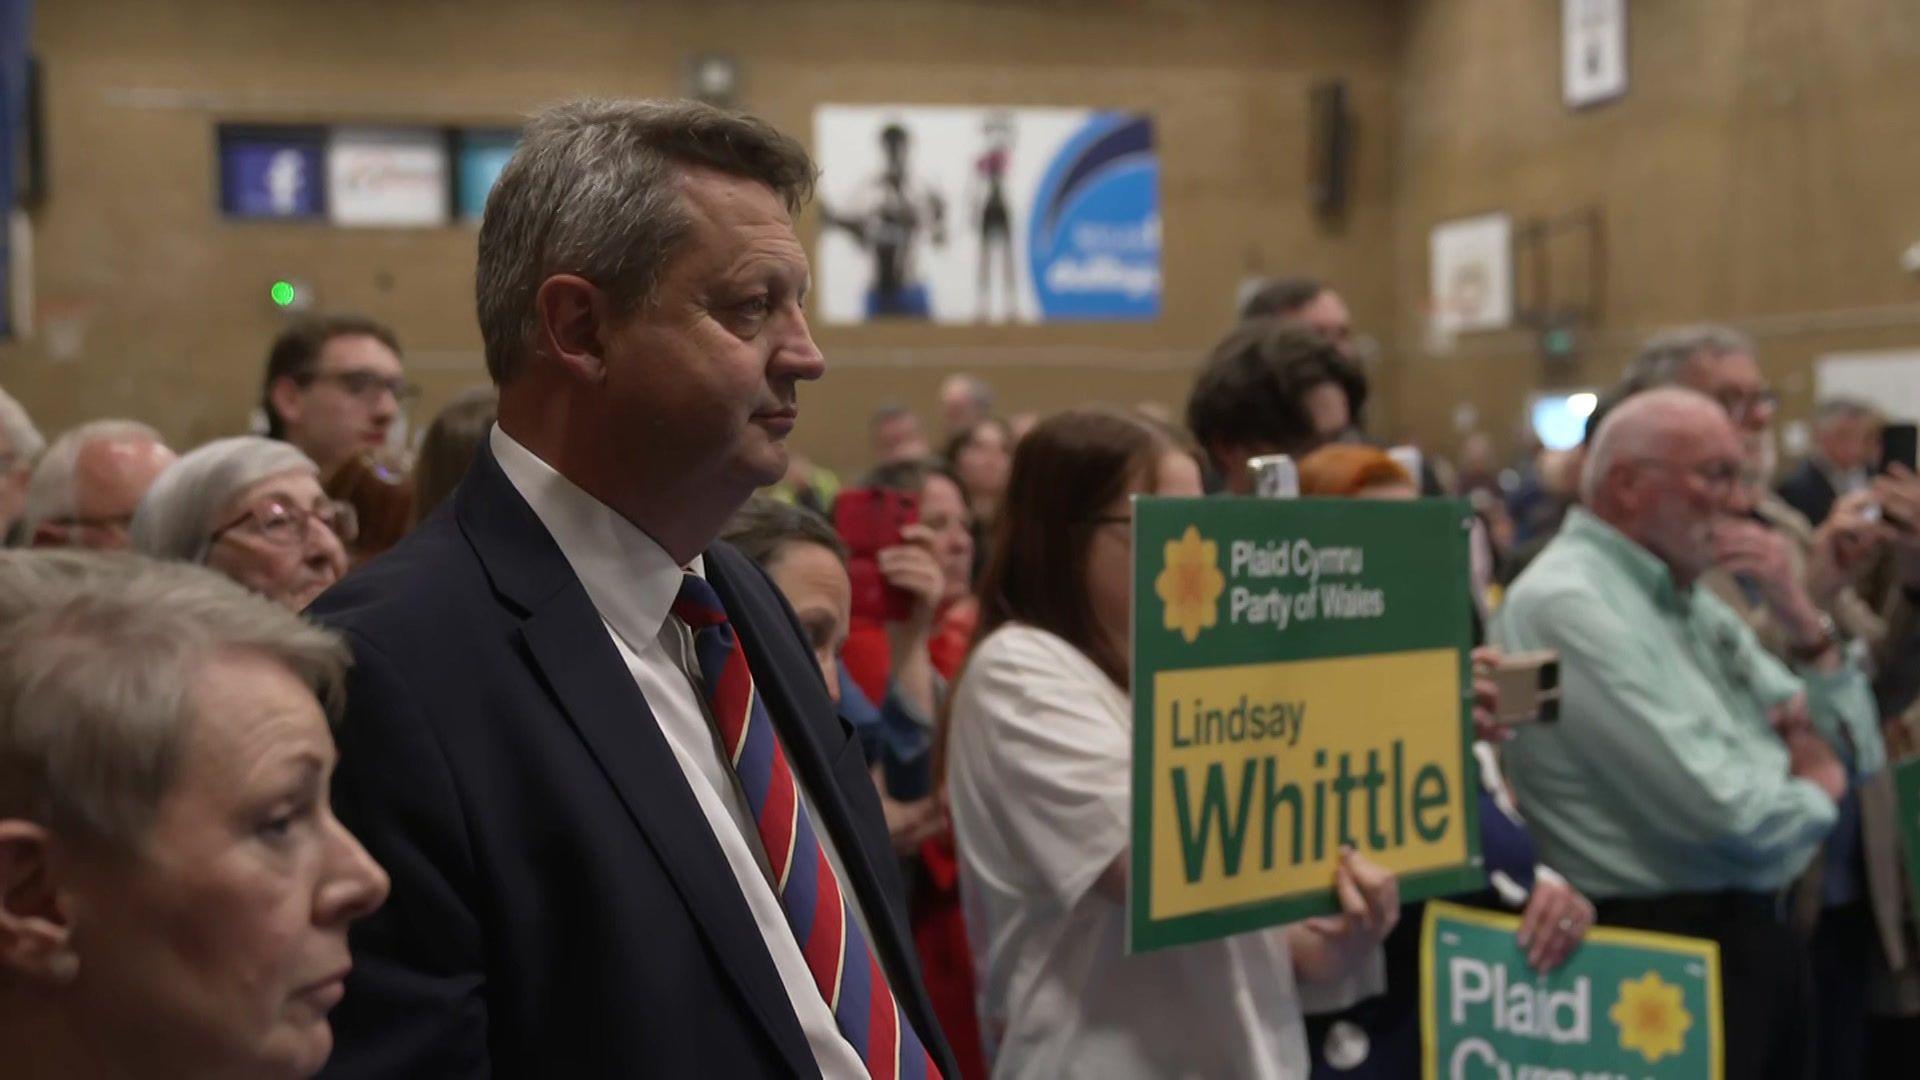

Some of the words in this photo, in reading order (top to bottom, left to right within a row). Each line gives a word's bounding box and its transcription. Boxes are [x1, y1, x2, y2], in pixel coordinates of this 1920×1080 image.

[1230, 539, 1290, 577] Plaid
[1292, 538, 1364, 583] Cymru
[1230, 586, 1293, 631] Party
[1294, 583, 1318, 621] of
[1319, 582, 1385, 619] Wales
[1171, 695, 1305, 748] Lindsay
[1170, 739, 1450, 885] Whittle
[1449, 956, 1592, 1044] Plaid
